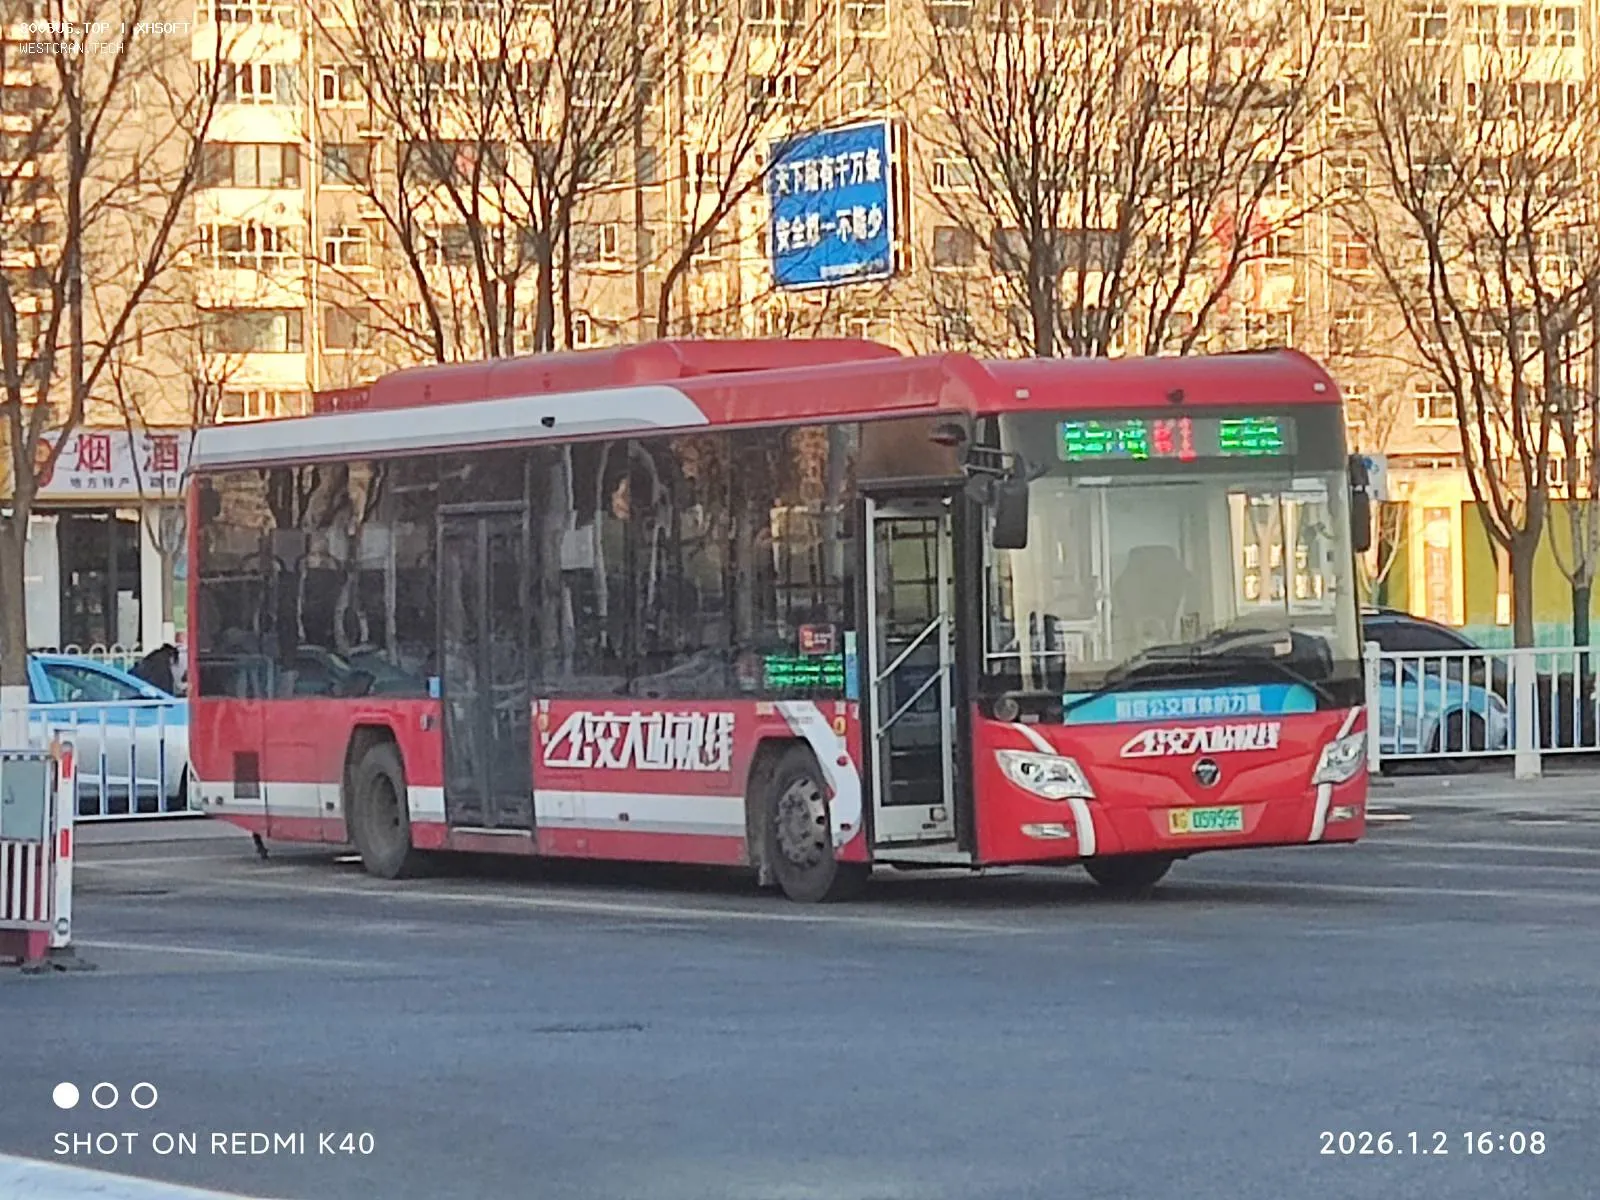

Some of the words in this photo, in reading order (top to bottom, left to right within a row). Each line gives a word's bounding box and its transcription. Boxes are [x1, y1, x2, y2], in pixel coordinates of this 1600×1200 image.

[74, 433, 179, 473] 烟酒
[544, 711, 735, 772] 公交大站快线
